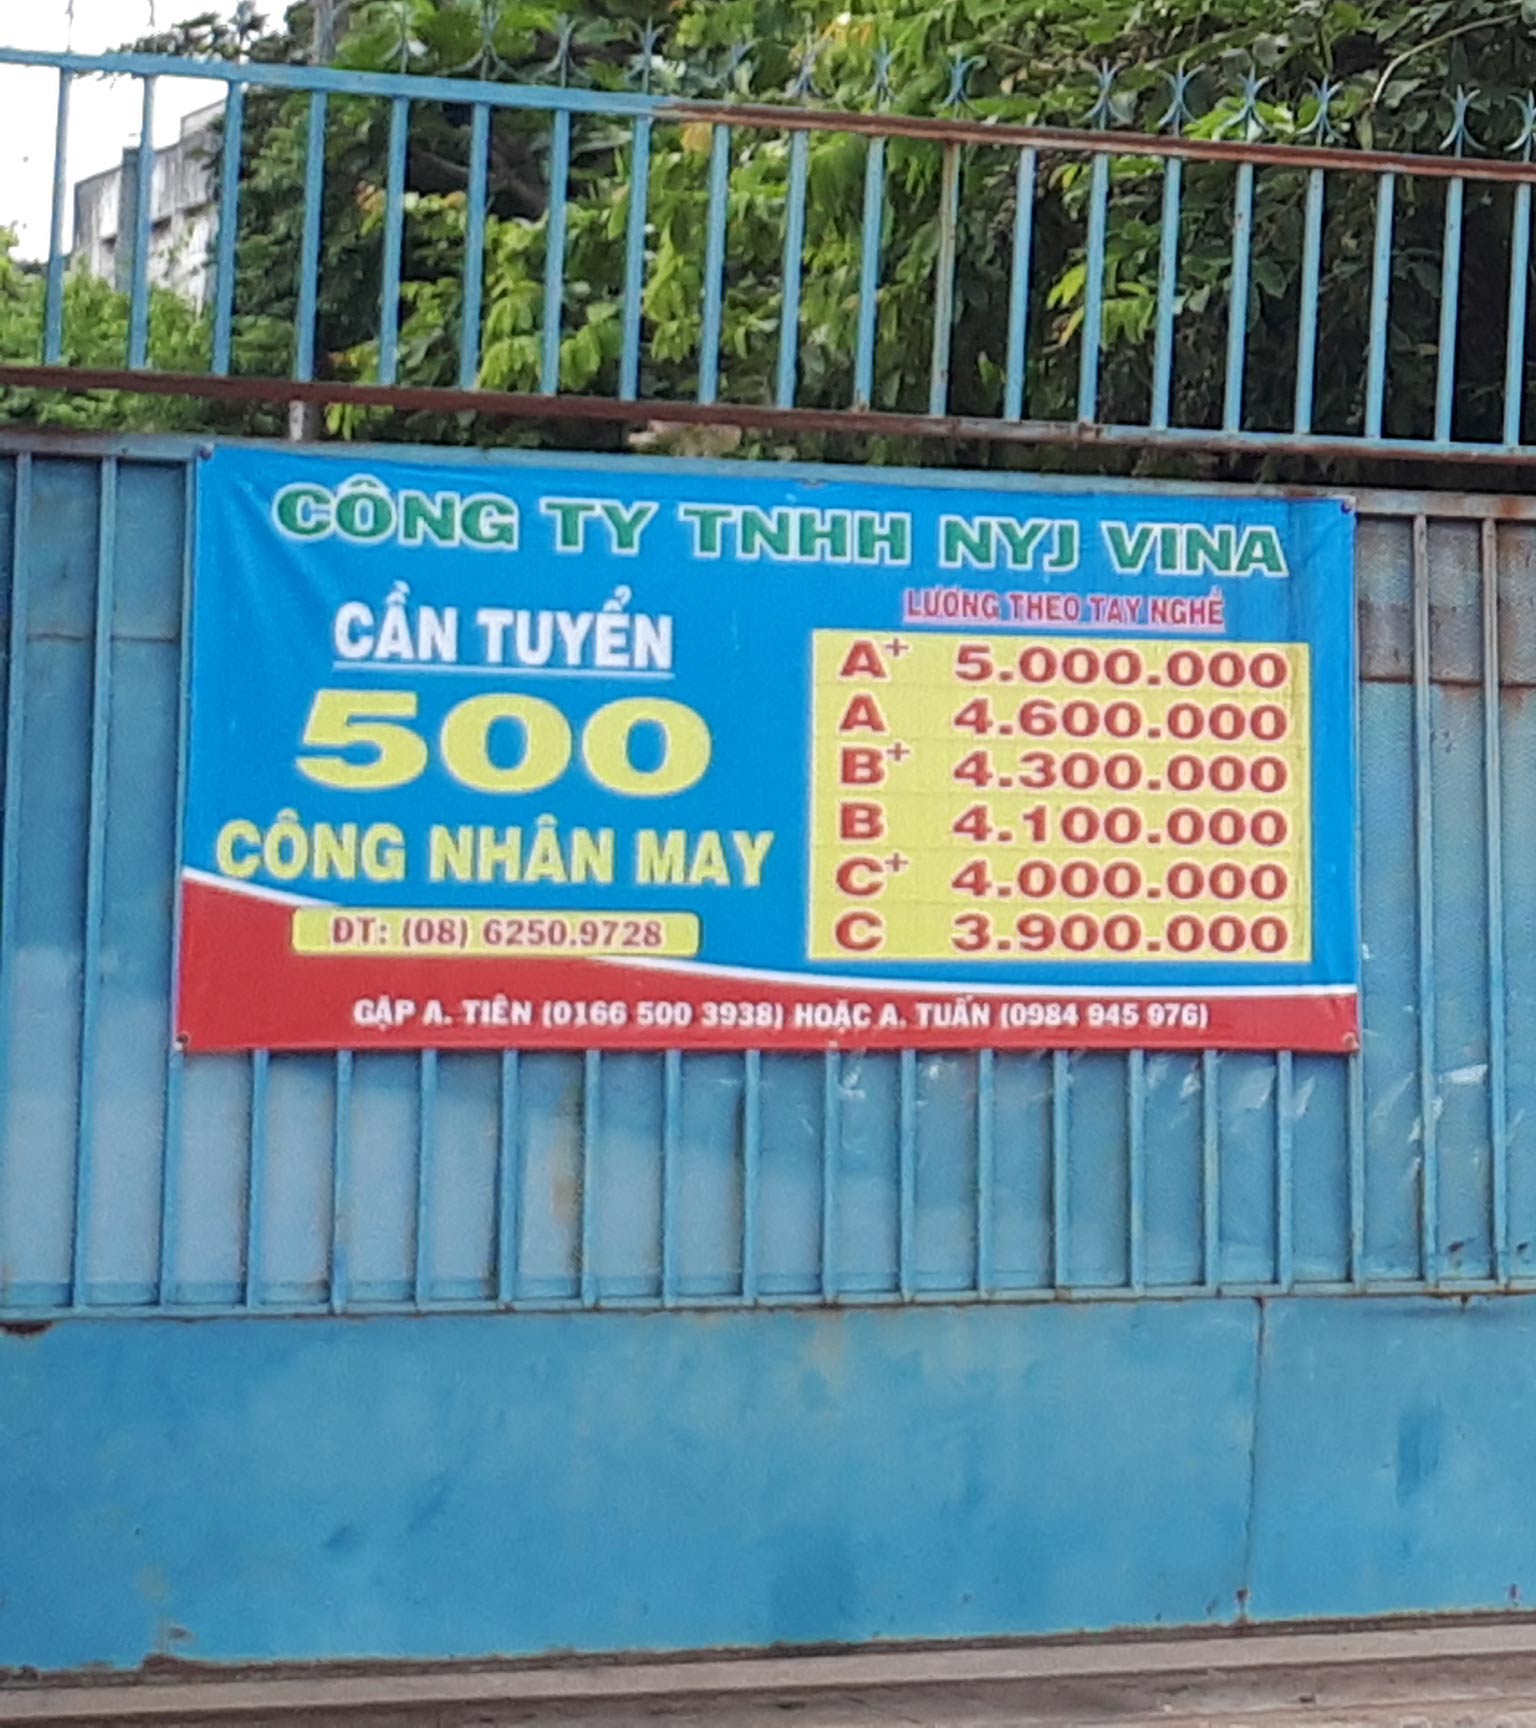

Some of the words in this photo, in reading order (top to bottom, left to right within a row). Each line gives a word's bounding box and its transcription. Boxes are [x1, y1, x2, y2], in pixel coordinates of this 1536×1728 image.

[273, 474, 519, 551] CÔNG
[540, 498, 658, 555] TY
[679, 502, 911, 567] TNHH
[939, 515, 1081, 574] NYJ
[1101, 520, 1289, 577] VINA
[334, 579, 457, 661] CẦN
[477, 585, 674, 669] TUYỂN
[1010, 593, 1080, 622] THEO
[1090, 596, 1140, 624] TAY
[955, 644, 1288, 689] 5.000.000
[838, 693, 888, 733] A
[952, 697, 1288, 741] 4.600.000
[295, 689, 712, 796] 500
[952, 750, 1288, 794] 4.300.000
[839, 801, 885, 841] B
[952, 804, 1288, 847] 4.100.000
[215, 809, 406, 881] CÔNG
[428, 814, 614, 883] NHÂN
[635, 829, 774, 886] MAY
[951, 858, 1288, 901] 4.000.000
[332, 915, 389, 946] ĐT:
[403, 915, 470, 948] (08)
[484, 917, 663, 948] 6250.9728
[835, 910, 884, 952] C
[951, 912, 1288, 954] 3.900.000
[353, 994, 416, 1032] GẶP
[423, 1000, 453, 1026] A.
[462, 994, 533, 1026] TIÊN
[542, 1000, 629, 1029] (0166
[637, 1000, 692, 1028] 500
[701, 1000, 783, 1030] 3938)
[794, 998, 871, 1033] HOẶC
[879, 1002, 907, 1029] A.
[915, 995, 990, 1029] TUẤN
[1001, 1002, 1079, 1030] (0984
[1088, 1002, 1140, 1029] 945
[1147, 1002, 1209, 1031] 976)
